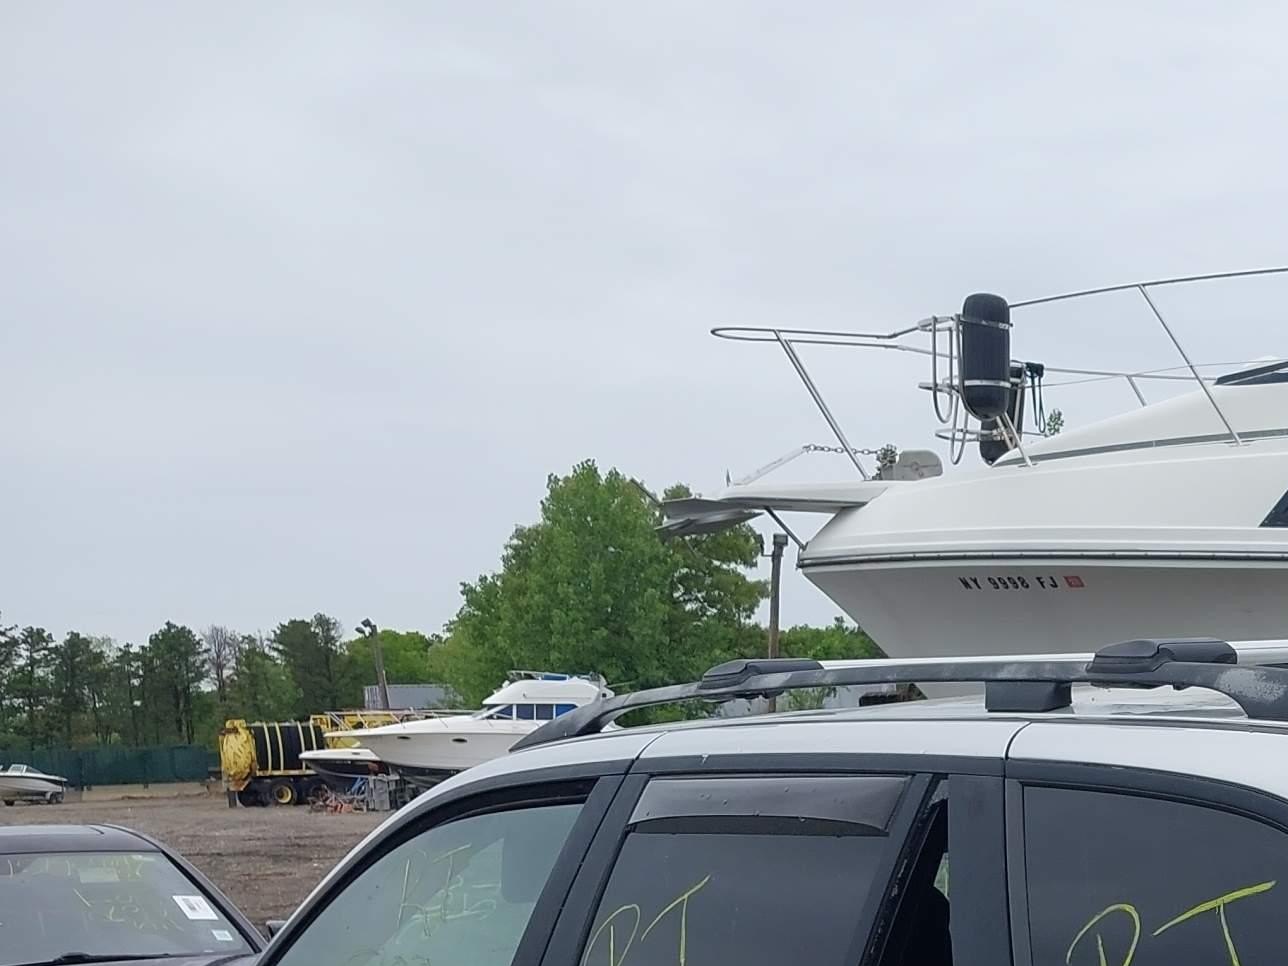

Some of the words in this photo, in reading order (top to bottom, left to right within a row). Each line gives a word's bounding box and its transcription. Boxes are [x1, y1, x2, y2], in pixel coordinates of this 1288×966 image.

[958, 576, 983, 590] NY
[987, 576, 1030, 590] 9998
[1036, 576, 1059, 590] FJ
